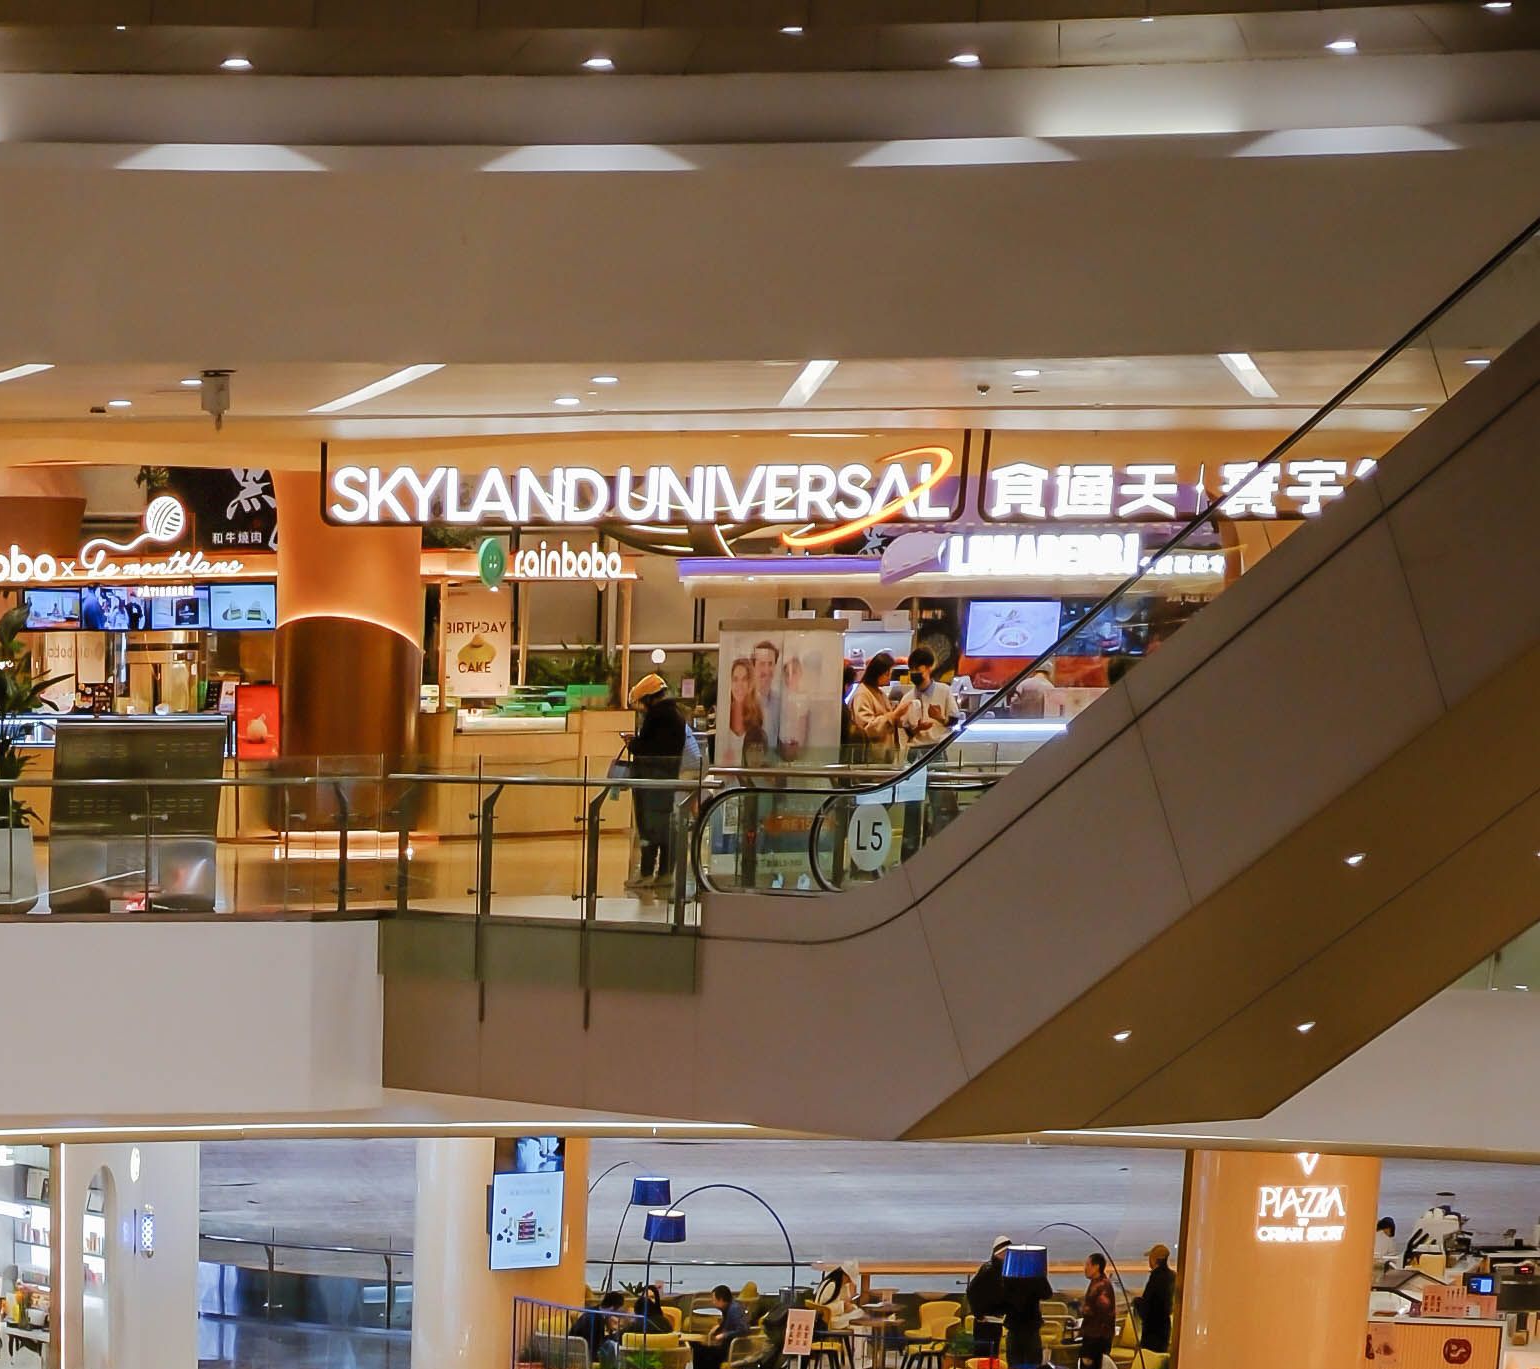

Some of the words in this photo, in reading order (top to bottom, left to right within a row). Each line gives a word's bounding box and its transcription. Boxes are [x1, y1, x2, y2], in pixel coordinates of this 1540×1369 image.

[331, 466, 606, 522] SKYLAND
[616, 462, 950, 521] UNIVERSAL
[991, 461, 1179, 519] 食通天
[514, 541, 621, 578] rainbobo
[446, 621, 507, 634] BIRTHDAY
[458, 661, 492, 674] CAKE
[856, 819, 883, 851] L5
[1258, 1186, 1346, 1218] PIAZZA
